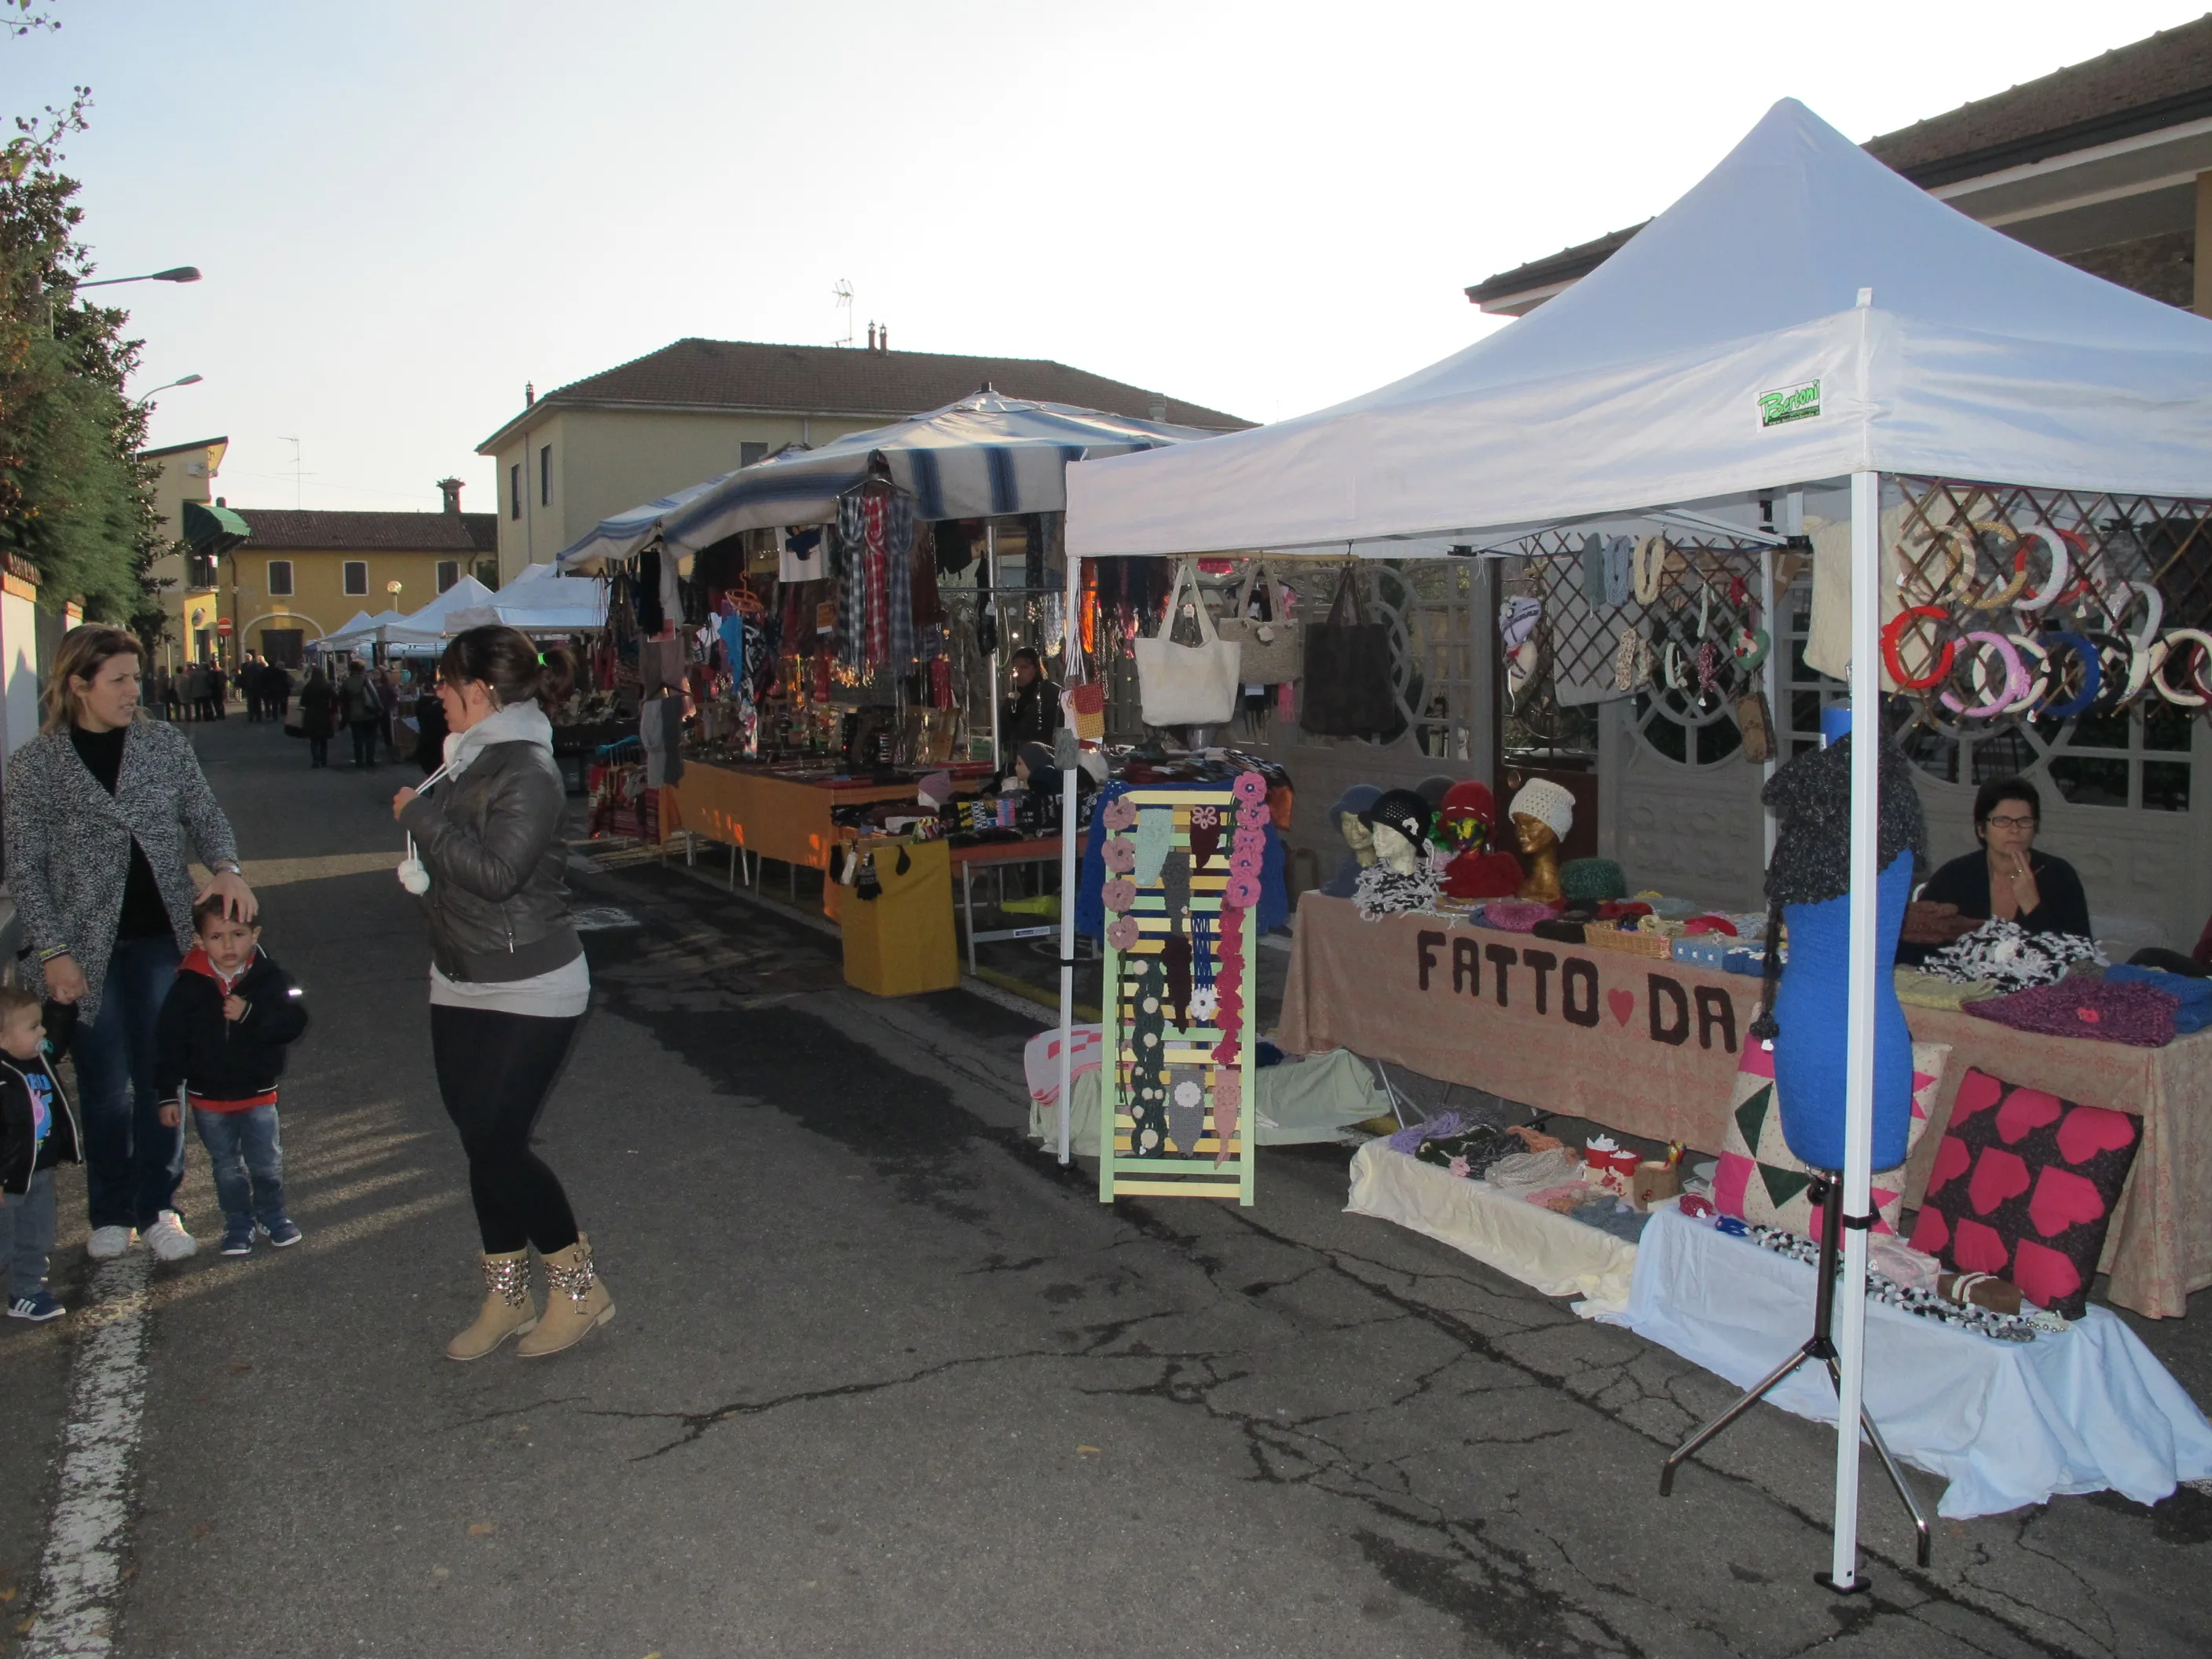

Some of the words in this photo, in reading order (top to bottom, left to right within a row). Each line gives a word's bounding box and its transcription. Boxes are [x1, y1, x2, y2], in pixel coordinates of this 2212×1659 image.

[1757, 379, 1818, 423] Bertoni
[1417, 930, 1600, 1027] FATTO
[1647, 973, 1737, 1053] DA
